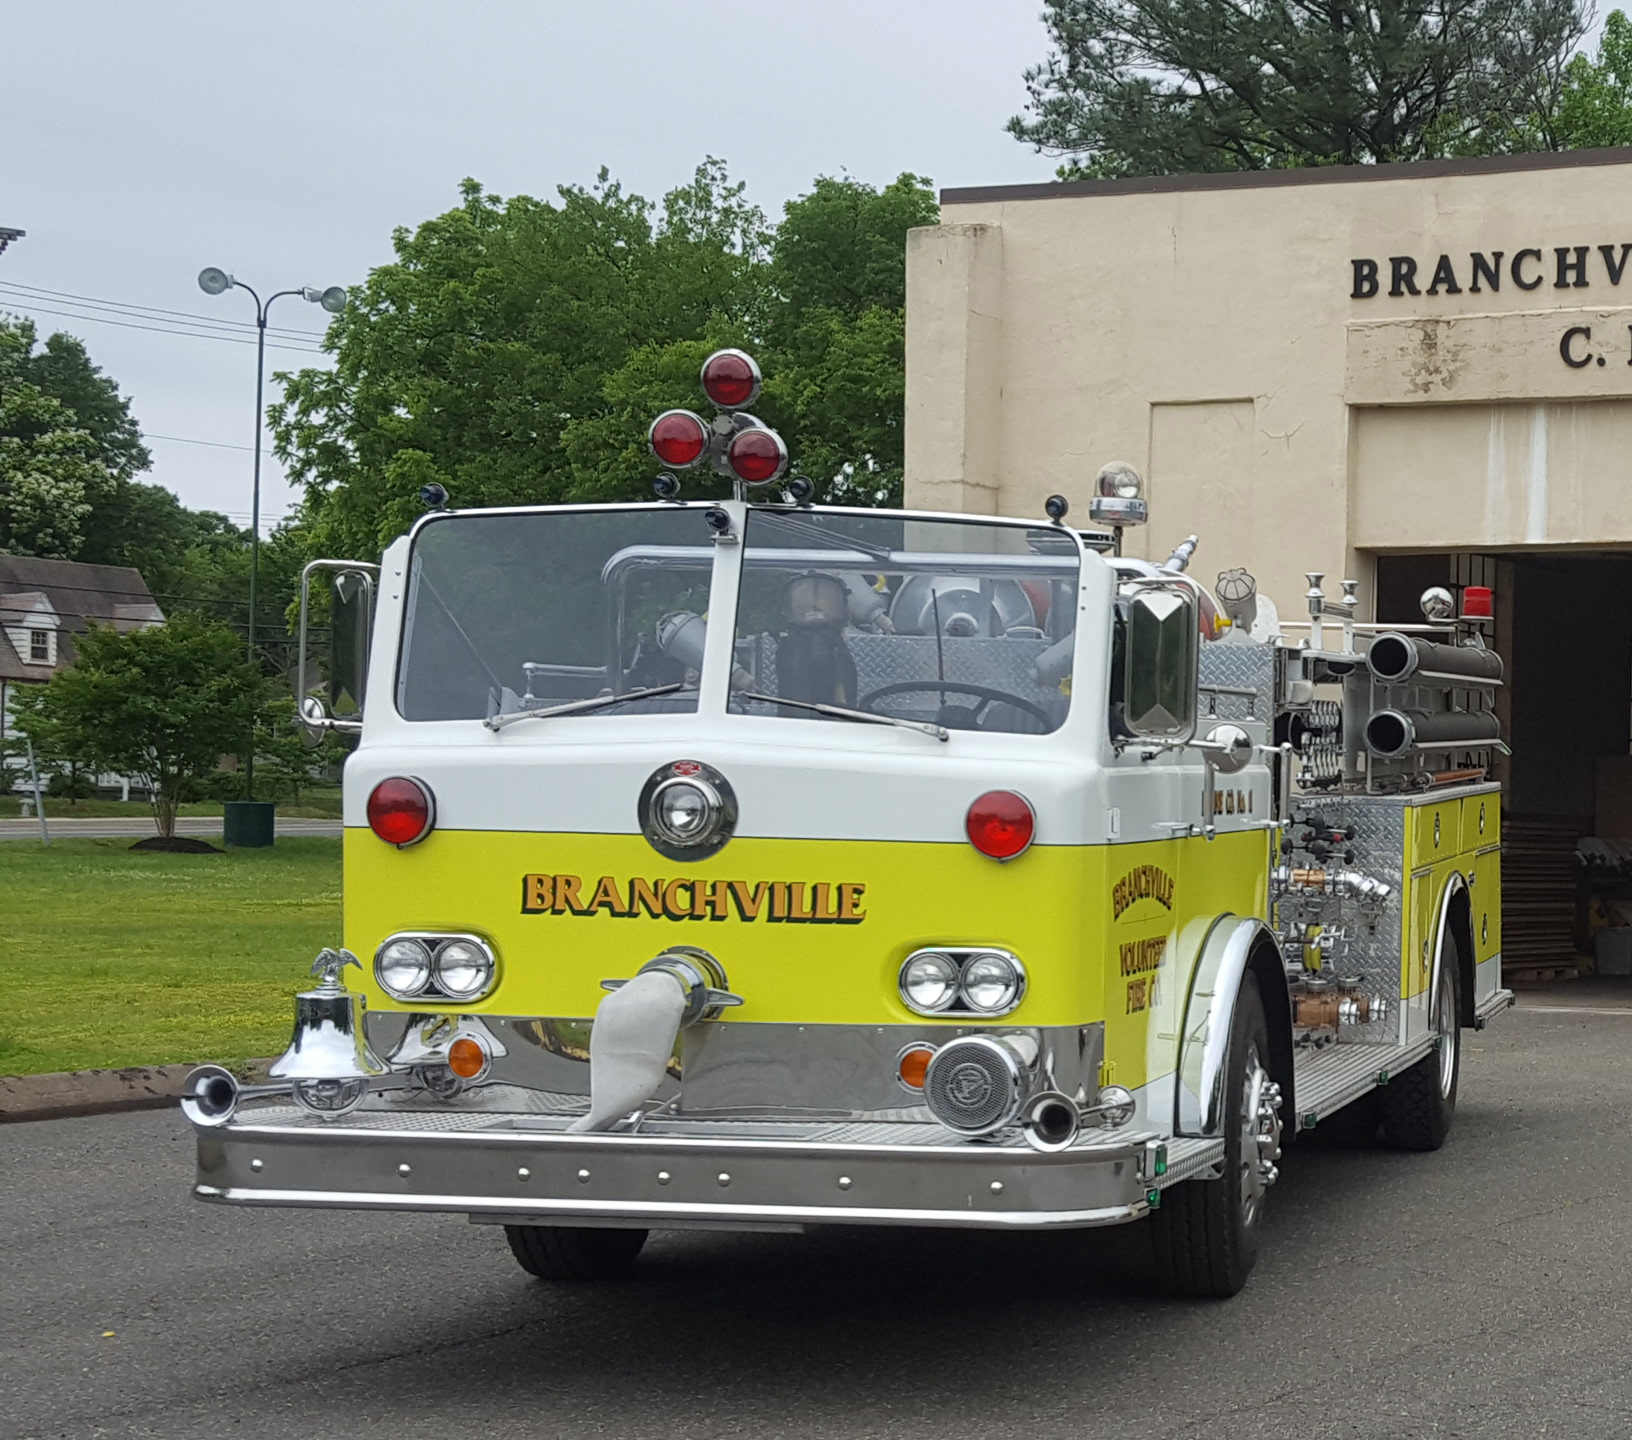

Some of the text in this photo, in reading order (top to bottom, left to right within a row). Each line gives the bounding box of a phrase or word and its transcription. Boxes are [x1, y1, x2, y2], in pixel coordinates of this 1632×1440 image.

[1559, 326, 1606, 369] C.
[520, 873, 868, 925] BRANCHVILLE
[1112, 864, 1175, 922] BRANCHVILLE
